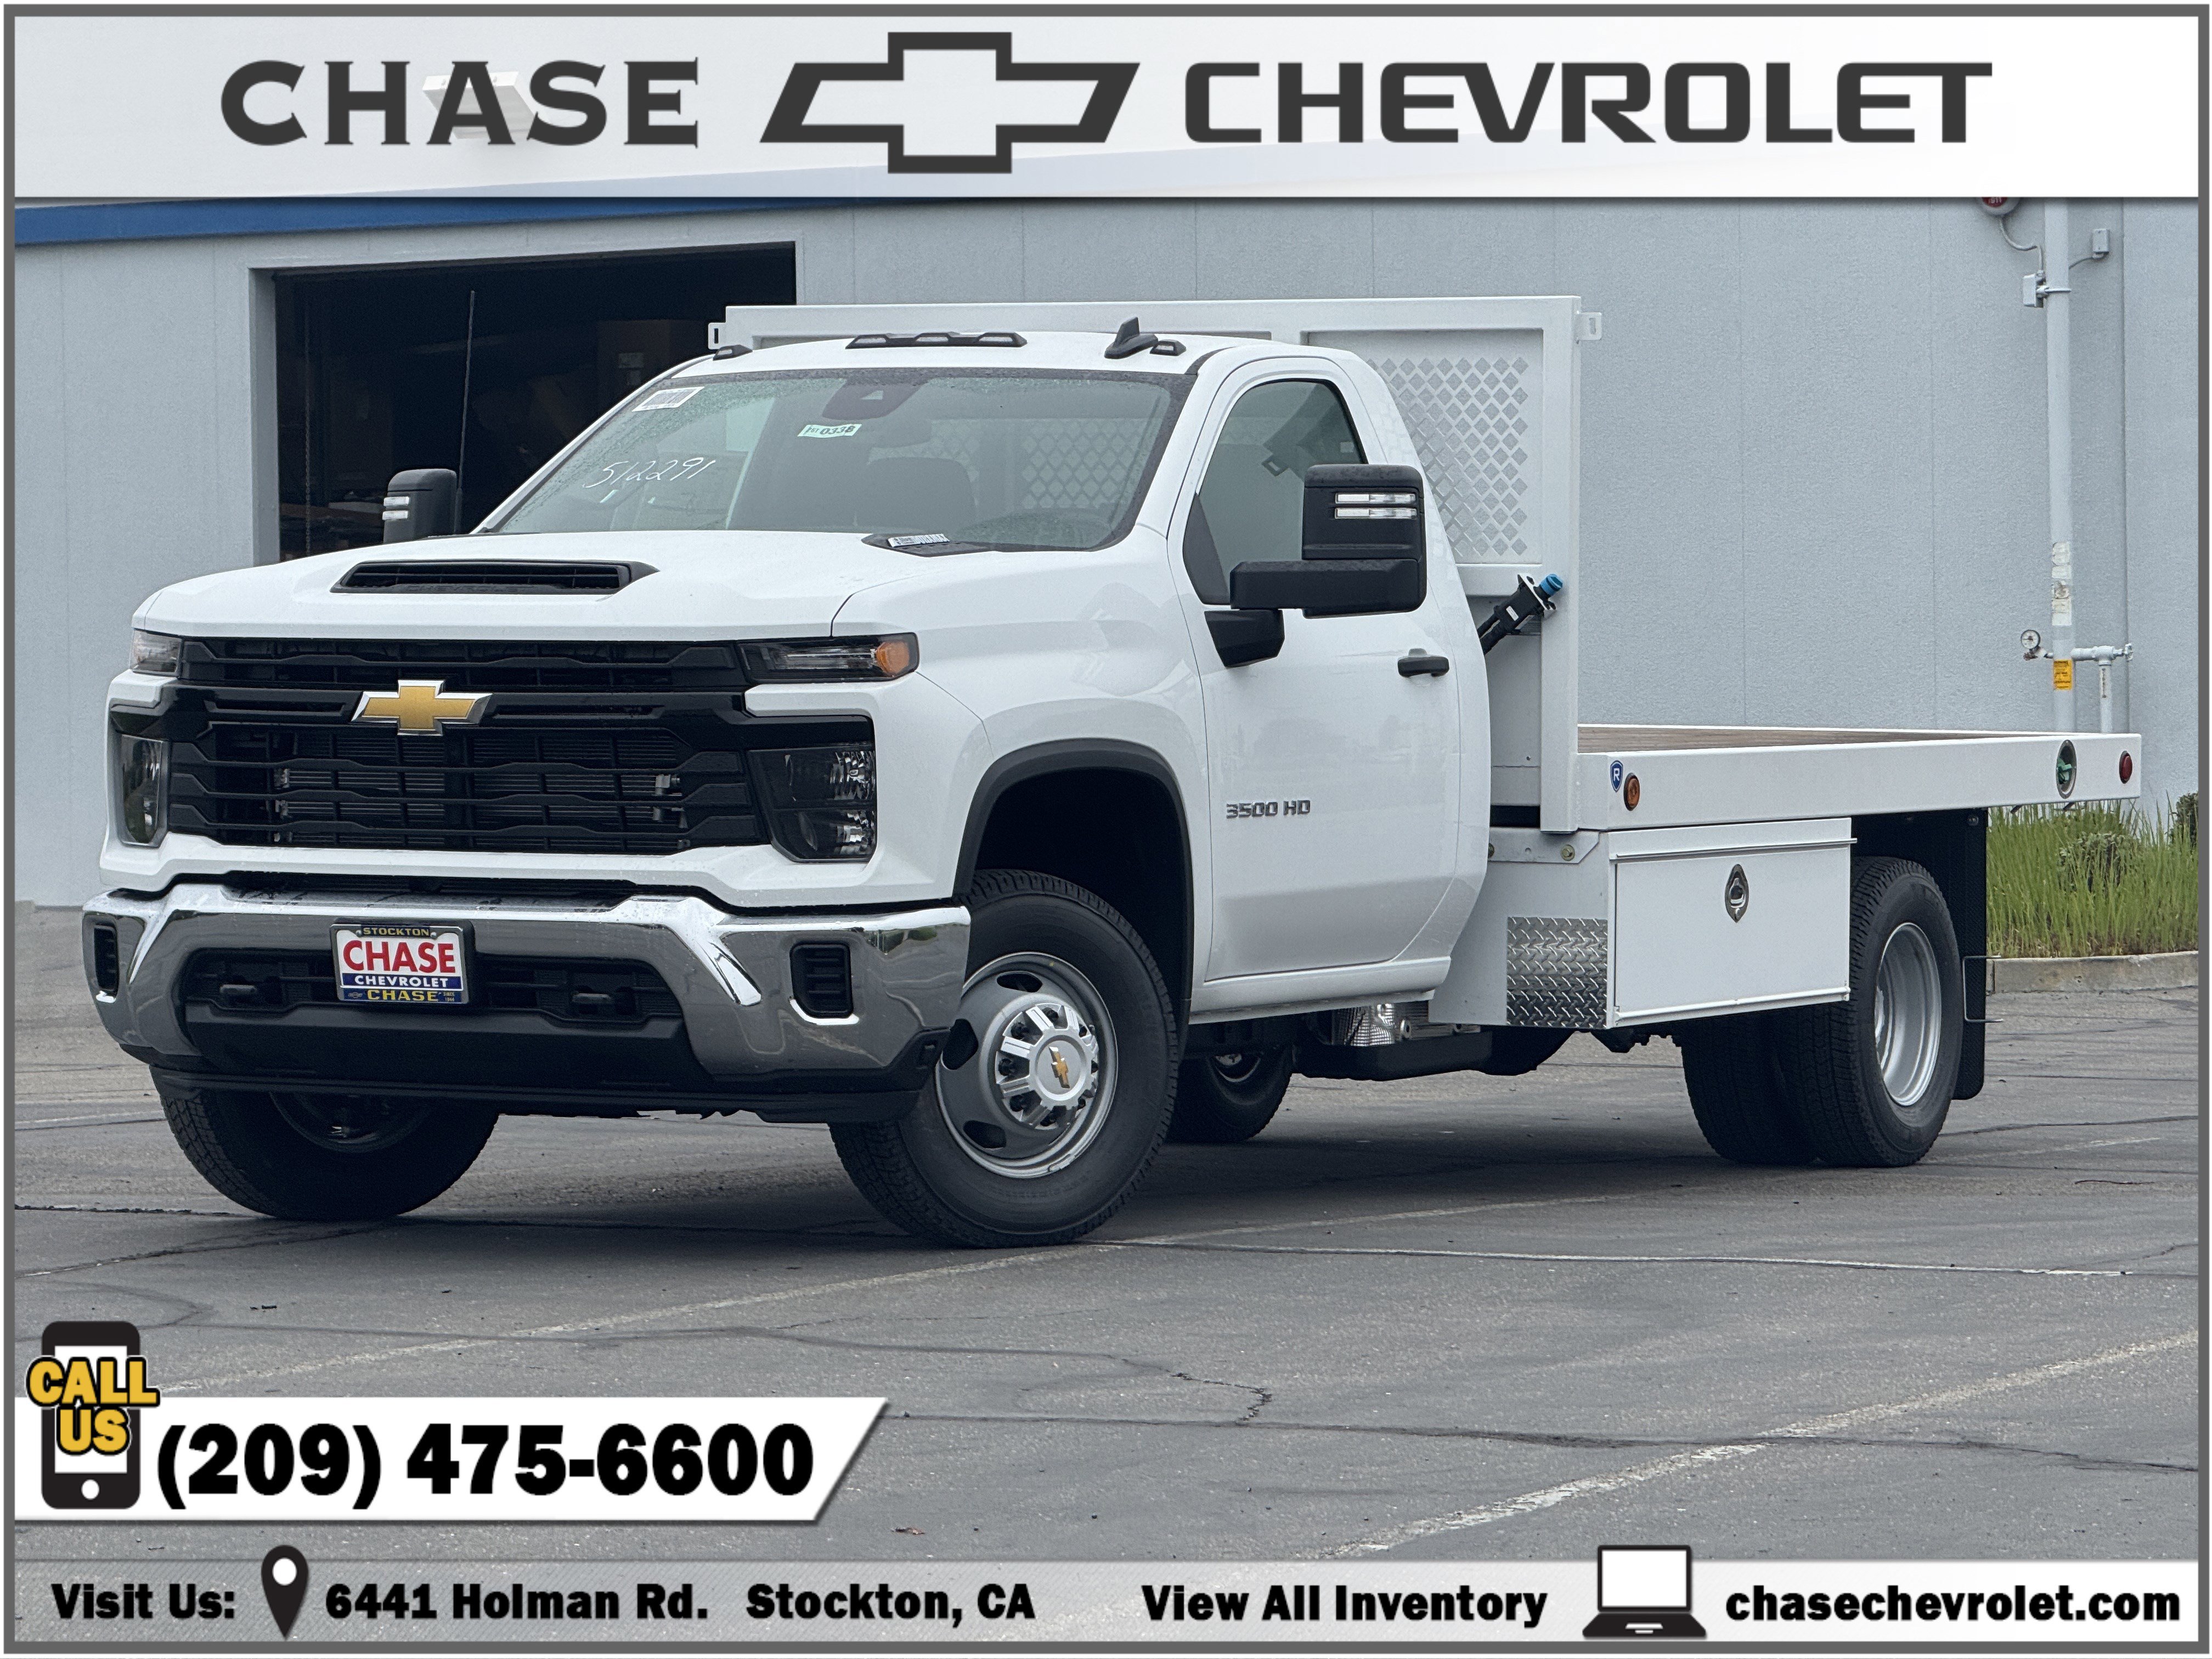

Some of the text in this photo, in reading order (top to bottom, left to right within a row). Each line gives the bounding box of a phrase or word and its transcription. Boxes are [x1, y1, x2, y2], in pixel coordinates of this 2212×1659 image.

[582, 457, 716, 488] 512291
[1613, 768, 1620, 782] R
[1226, 799, 1311, 819] 3500 HD
[363, 927, 430, 936] STOCKTON
[343, 940, 456, 973] CHASE
[354, 975, 448, 988] CHEVROLET
[367, 990, 439, 1002] CHASE
